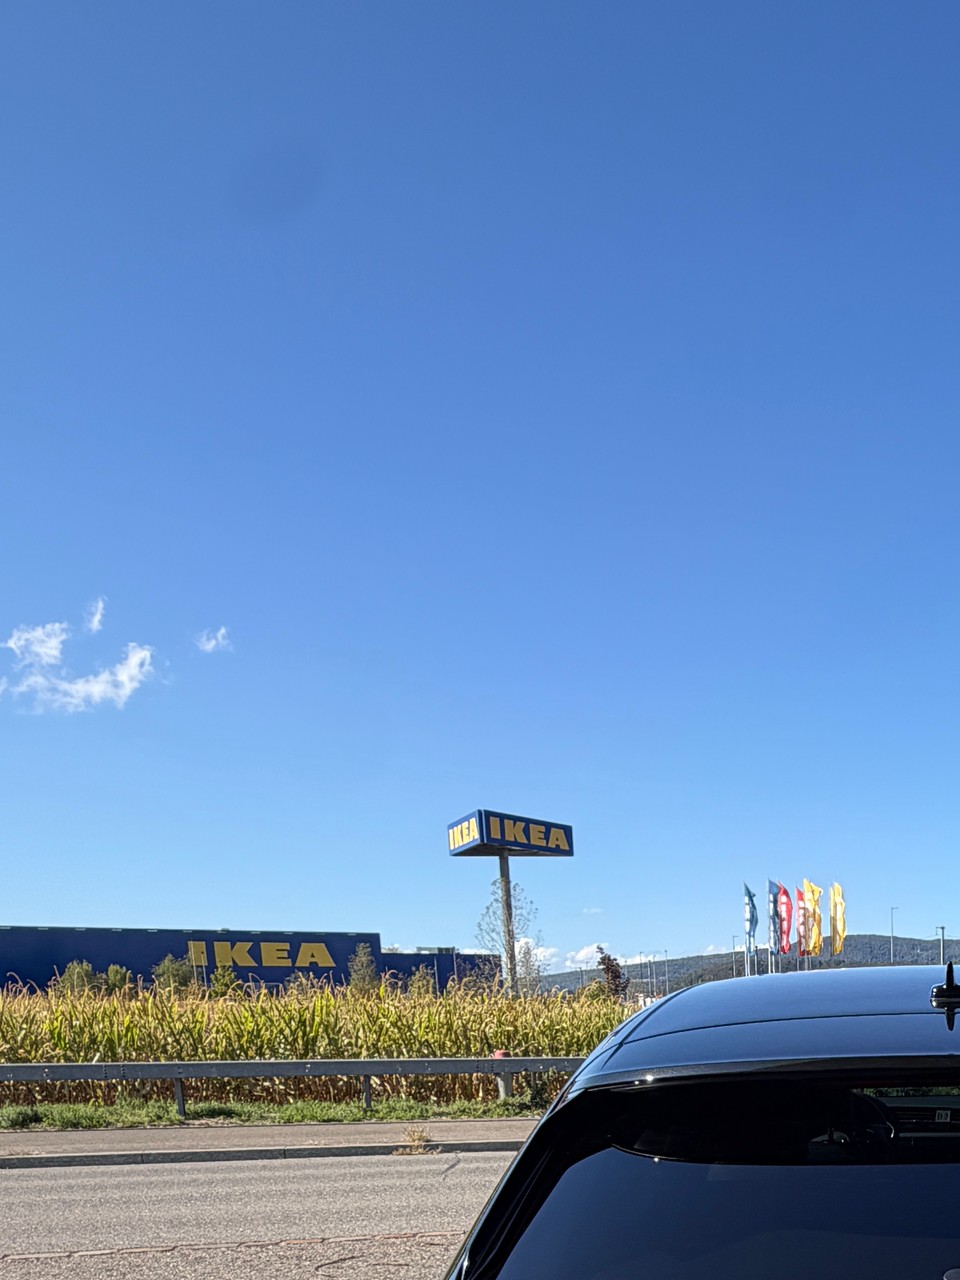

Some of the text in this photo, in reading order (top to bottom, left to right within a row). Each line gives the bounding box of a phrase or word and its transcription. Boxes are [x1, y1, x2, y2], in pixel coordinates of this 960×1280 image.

[449, 817, 479, 850] IKEA
[489, 816, 570, 850] IKEA
[187, 940, 336, 967] IKEA
